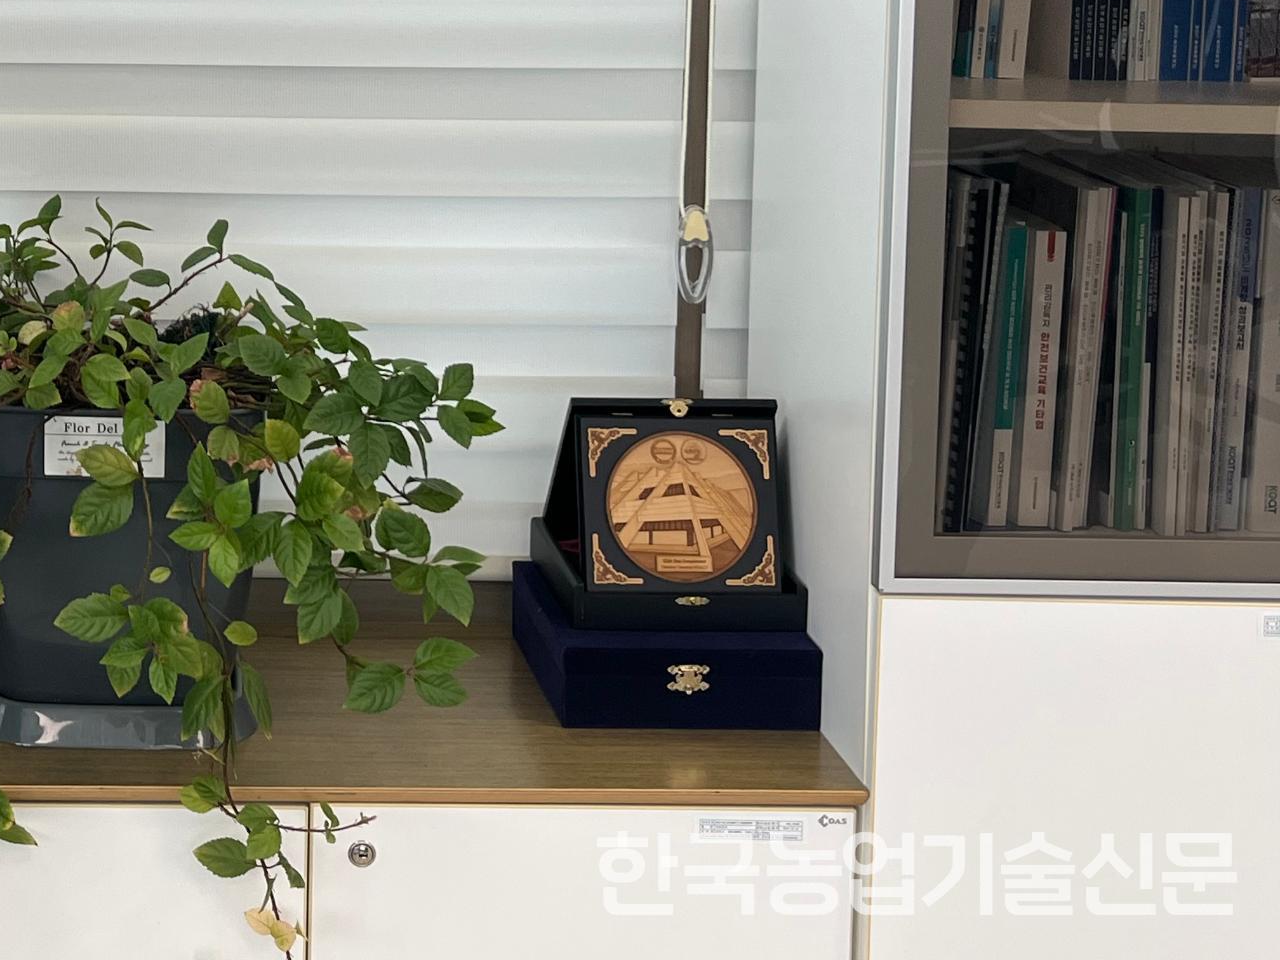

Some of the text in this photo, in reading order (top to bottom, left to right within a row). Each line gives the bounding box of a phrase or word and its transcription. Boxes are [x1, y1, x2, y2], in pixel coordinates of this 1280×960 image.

[64, 422, 118, 433] Flor Del
[1267, 485, 1278, 514] KOAT
[817, 814, 847, 828] COAS
